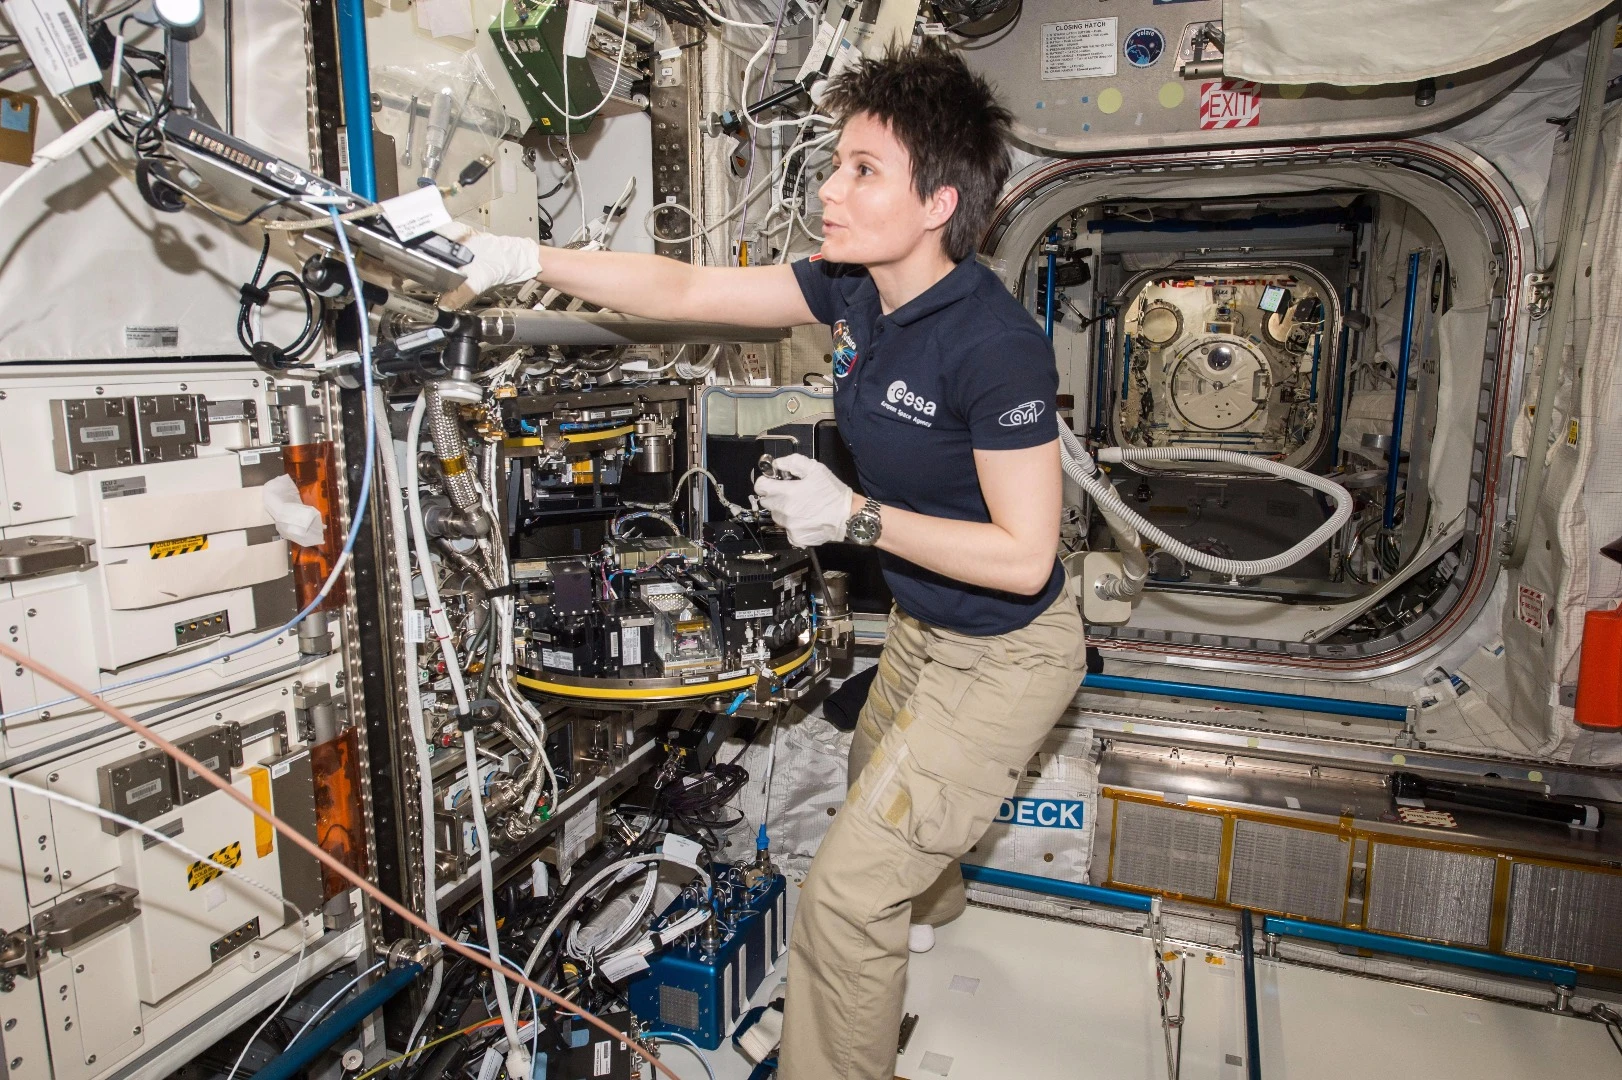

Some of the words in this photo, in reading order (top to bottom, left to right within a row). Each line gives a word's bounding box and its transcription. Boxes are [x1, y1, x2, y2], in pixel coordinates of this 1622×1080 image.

[1055, 24, 1083, 32] CLOSING
[1084, 21, 1106, 29] HATCH
[1209, 91, 1252, 119] EXIT
[897, 408, 912, 420] Space
[913, 416, 932, 428] Agency
[995, 800, 1080, 827] DECK
